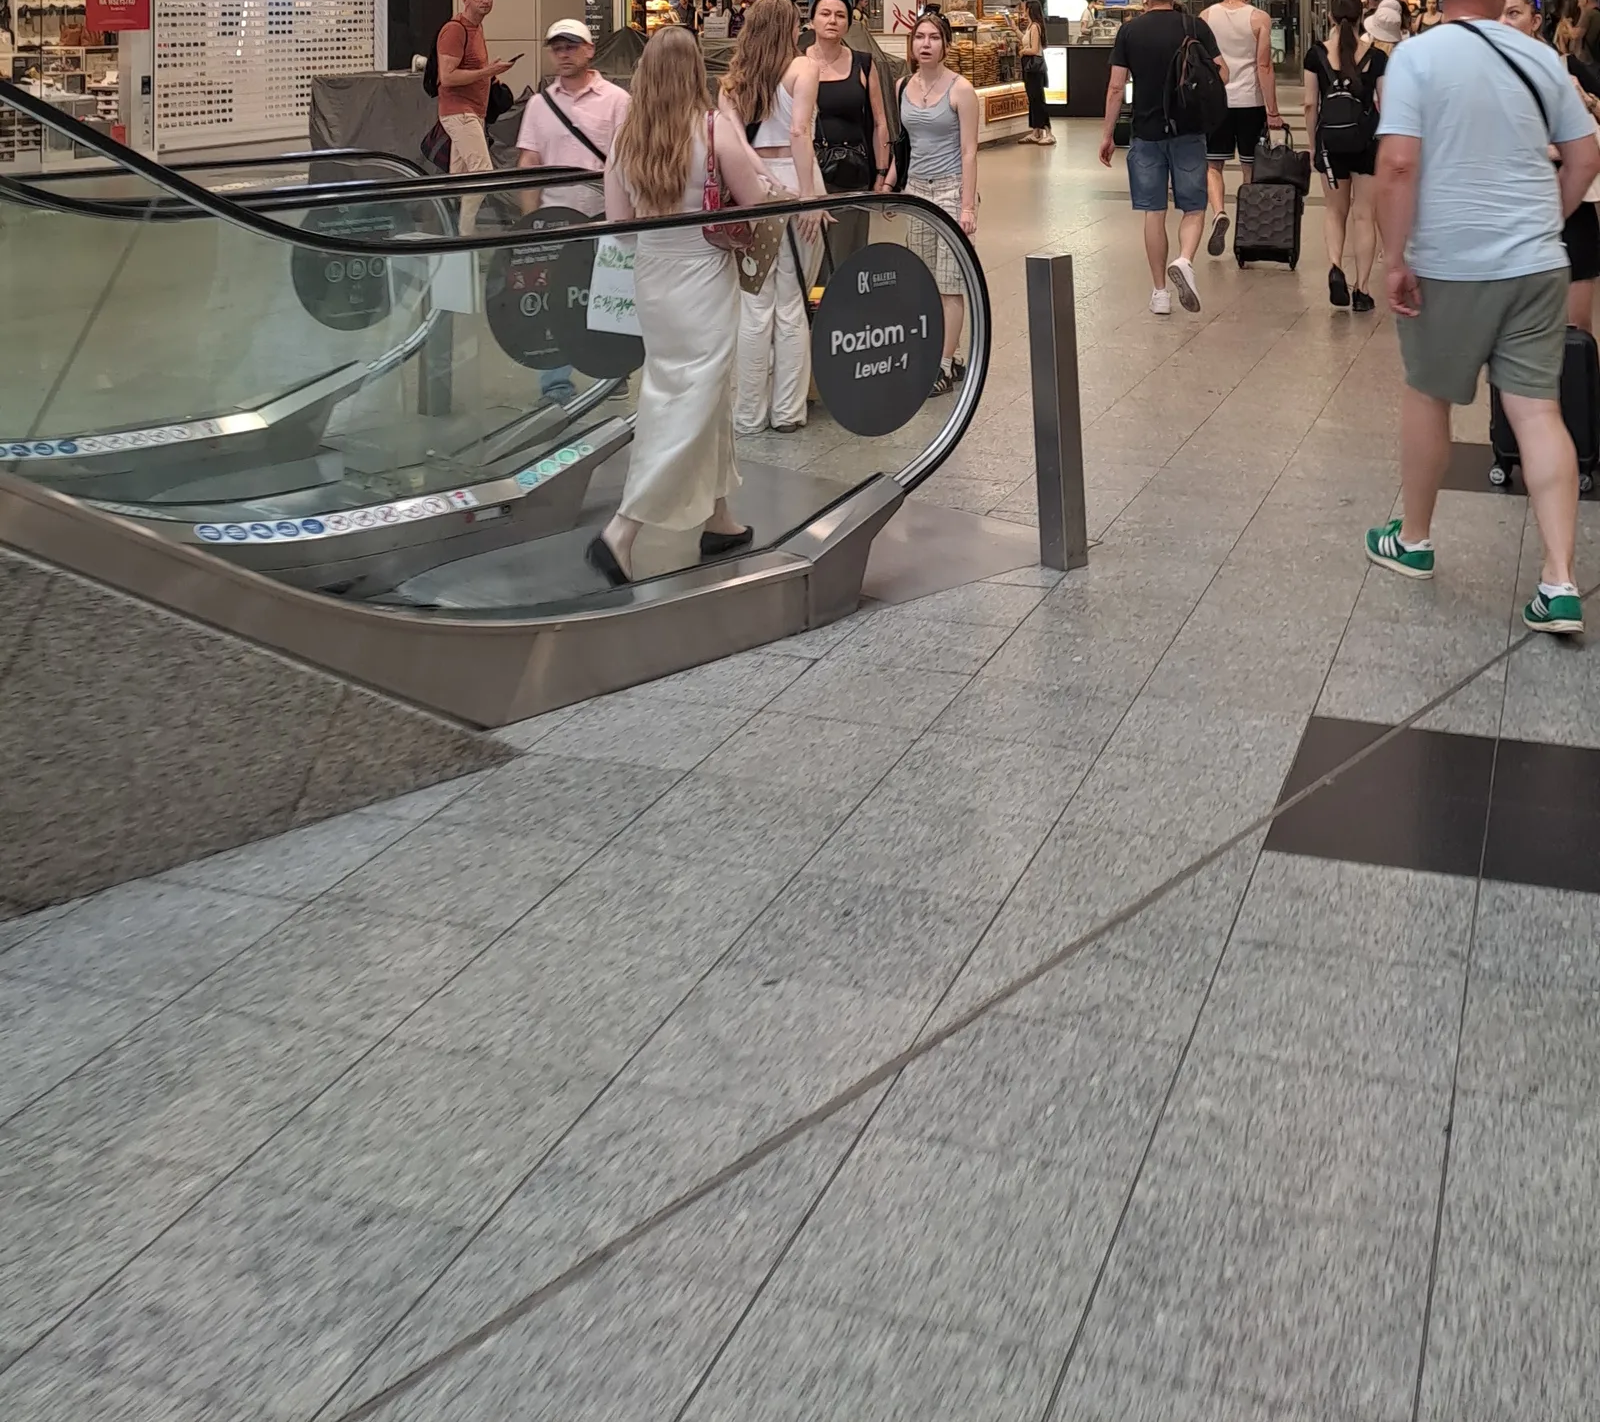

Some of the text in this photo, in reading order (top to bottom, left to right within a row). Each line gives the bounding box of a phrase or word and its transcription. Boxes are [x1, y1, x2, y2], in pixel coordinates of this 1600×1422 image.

[872, 271, 897, 283] GALERIA
[831, 315, 927, 355] Poziom -1
[855, 353, 908, 379] Level -1
